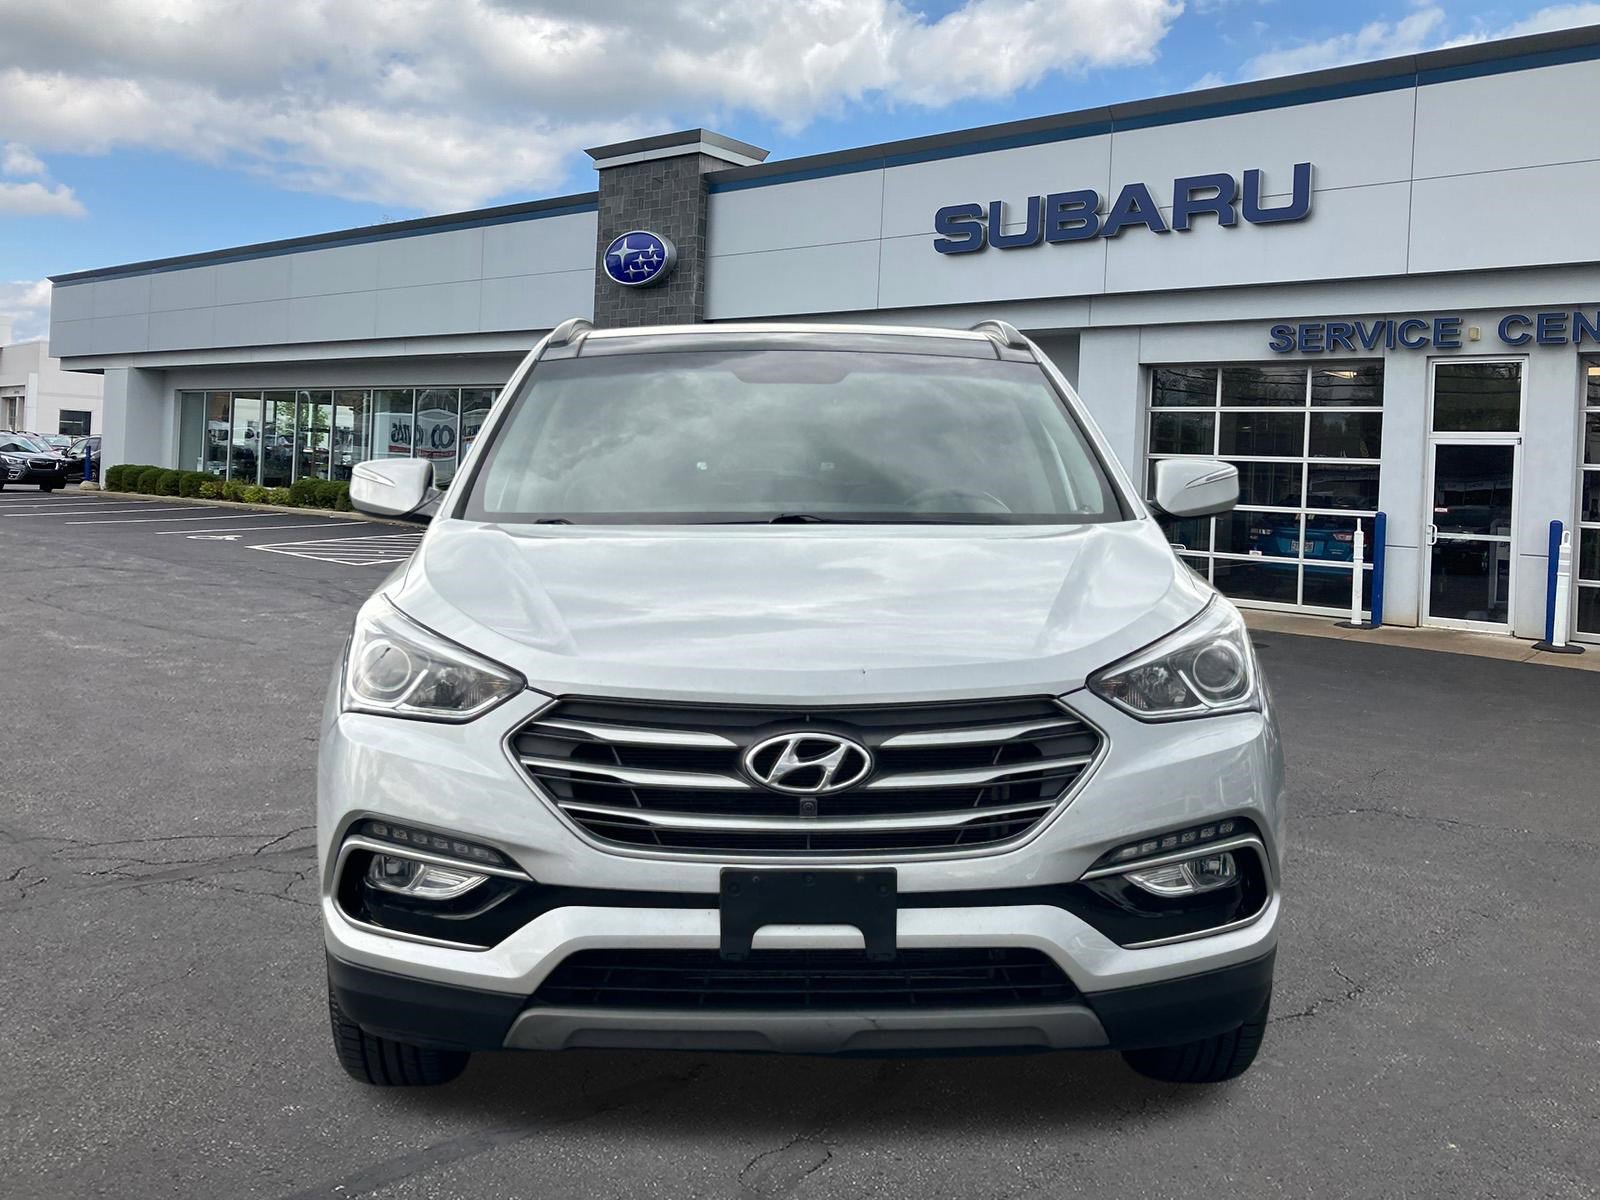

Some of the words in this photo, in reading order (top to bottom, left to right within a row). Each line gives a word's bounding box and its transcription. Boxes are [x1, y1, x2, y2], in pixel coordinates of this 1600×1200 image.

[933, 162, 1314, 255] SUBARU
[1268, 318, 1463, 353] SERVICE
[1497, 311, 1600, 347] CEN
